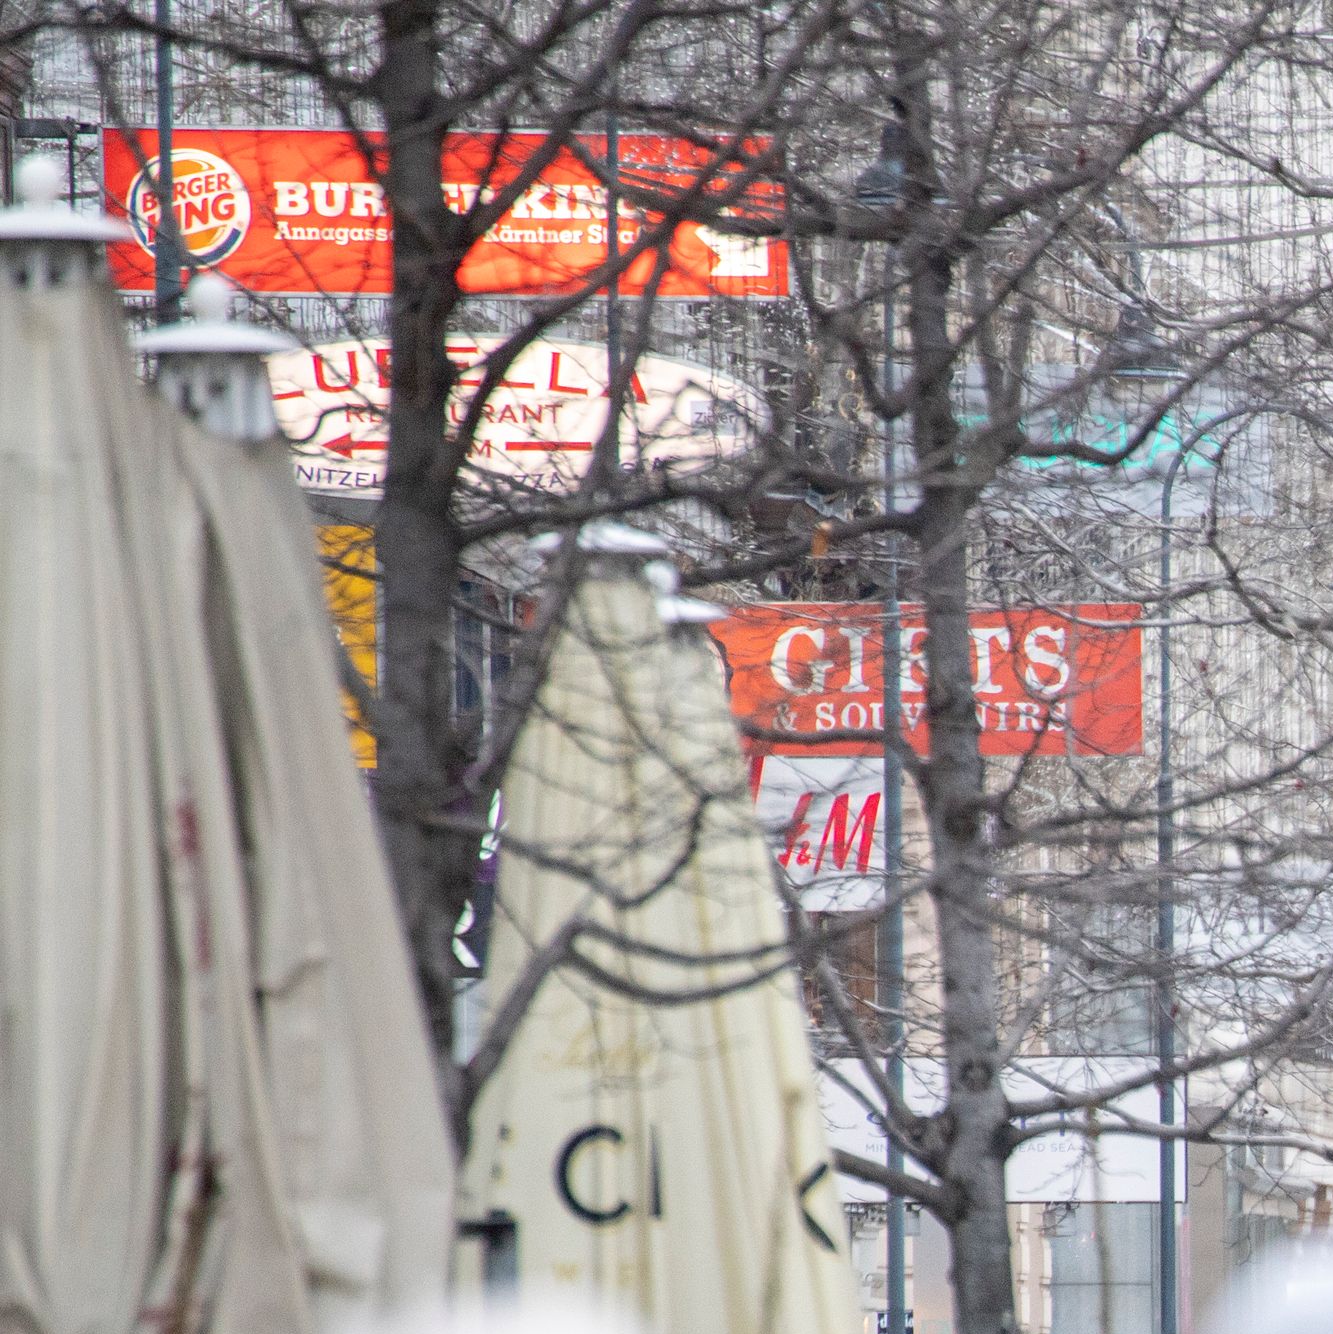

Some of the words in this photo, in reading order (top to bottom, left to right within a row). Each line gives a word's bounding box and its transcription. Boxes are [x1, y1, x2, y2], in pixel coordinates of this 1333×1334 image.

[142, 172, 231, 213] BRGER
[275, 221, 395, 245] Annagass
[482, 224, 583, 244] Kärntner
[345, 402, 563, 424] REURANT
[296, 464, 385, 489] NITZEL
[769, 625, 1071, 697] GIFTS
[815, 701, 1068, 732] SOUVNIRS
[1014, 1143, 1045, 1153] EAD
[1050, 1143, 1077, 1153] SEA
